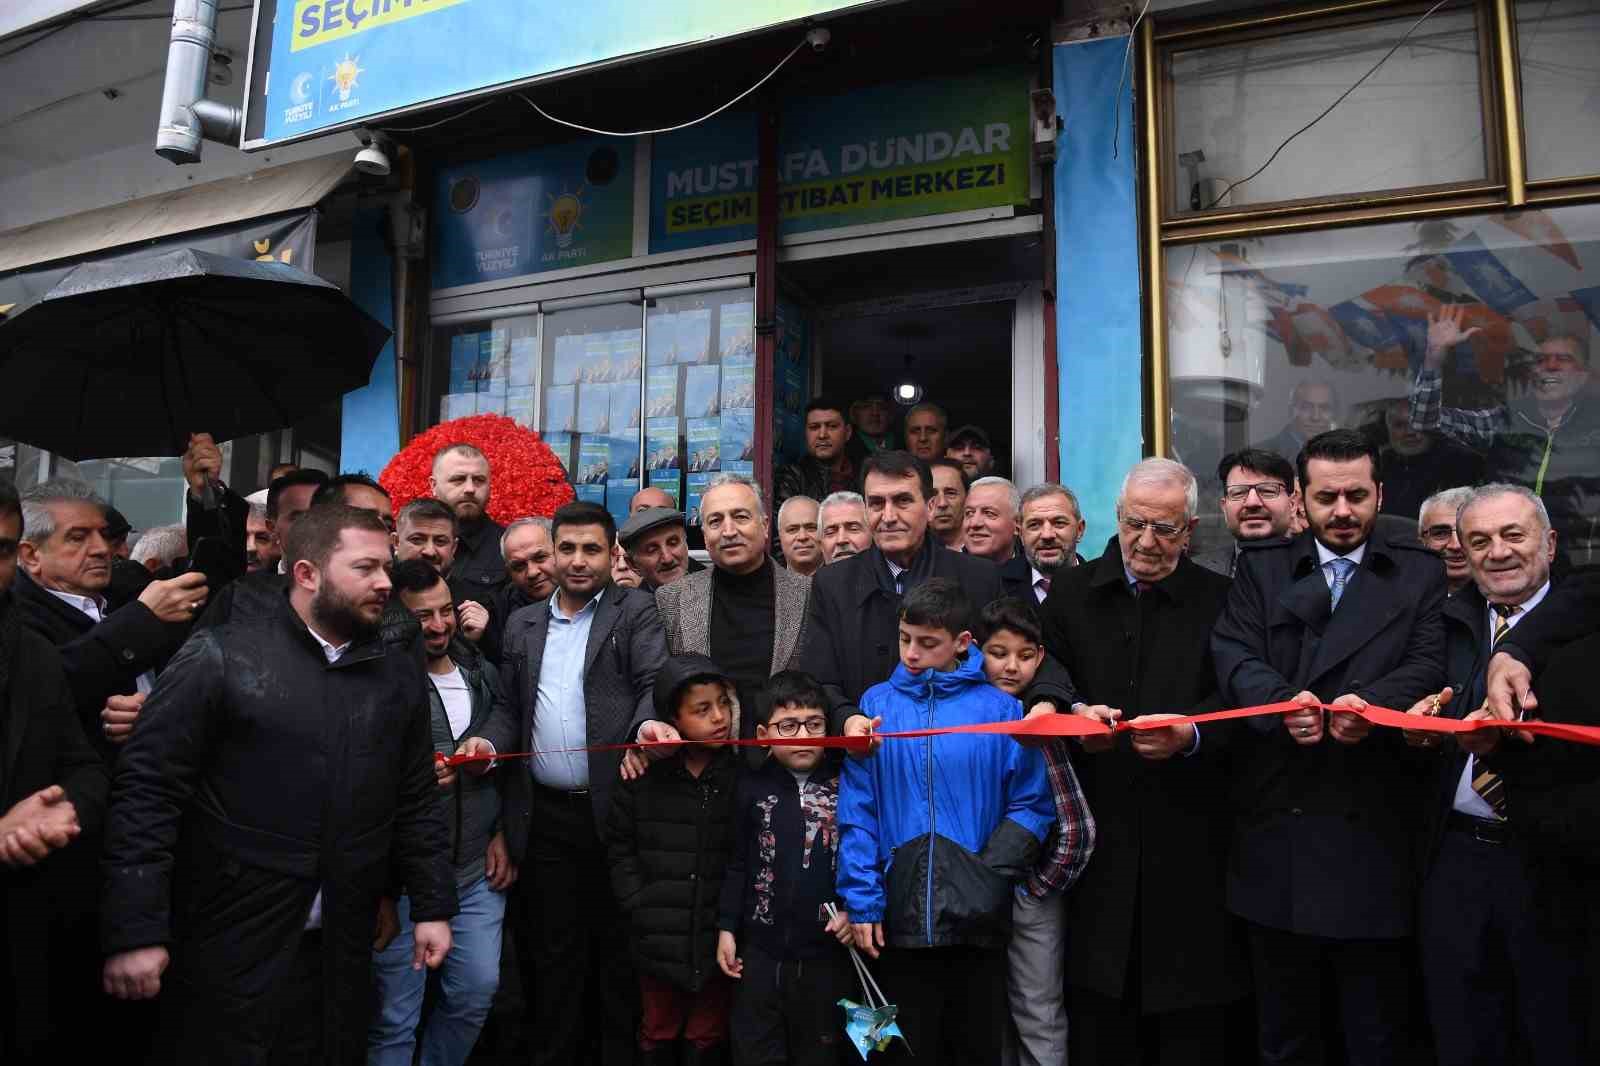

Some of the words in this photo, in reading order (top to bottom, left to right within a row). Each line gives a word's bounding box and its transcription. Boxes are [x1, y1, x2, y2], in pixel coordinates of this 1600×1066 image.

[666, 148, 830, 197] MUSTFA
[840, 122, 1011, 175] DÜNDAR
[671, 197, 751, 226] SEÇİM
[777, 183, 865, 212] TİBAT
[871, 163, 1005, 200] MERKEZİ
